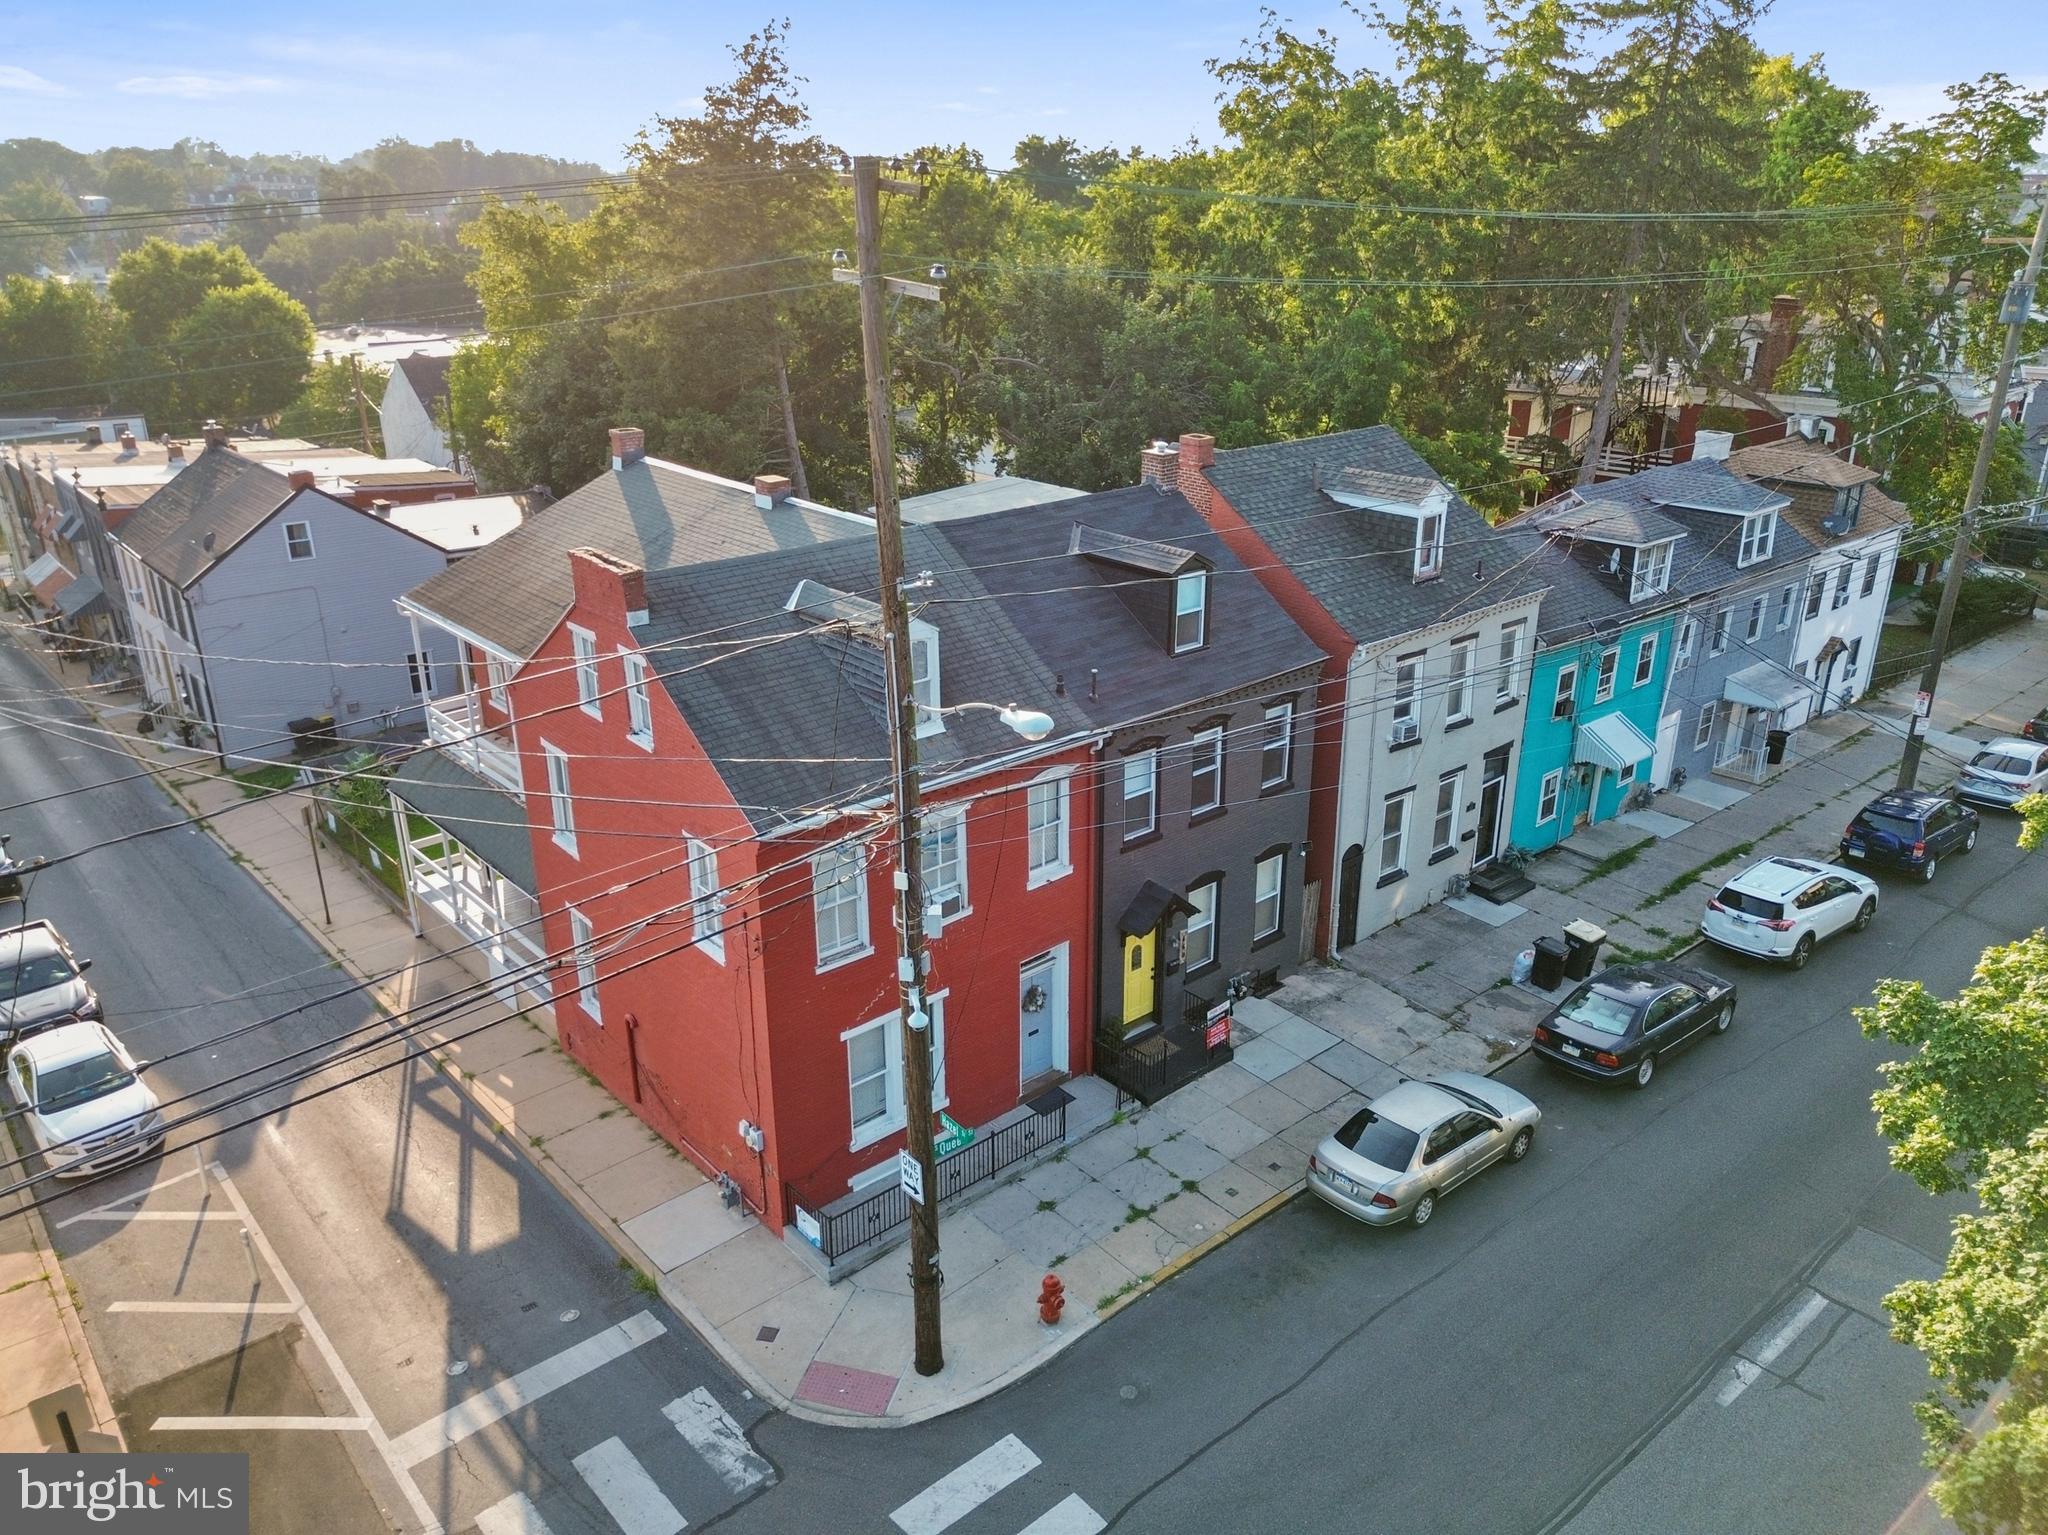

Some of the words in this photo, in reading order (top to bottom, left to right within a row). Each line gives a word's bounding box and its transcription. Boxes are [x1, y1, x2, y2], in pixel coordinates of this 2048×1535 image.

[941, 1113, 958, 1137] Hazel
[939, 1138, 962, 1155] Quee
[902, 1155, 918, 1176] ONE
[903, 1168, 919, 1184] WAY
